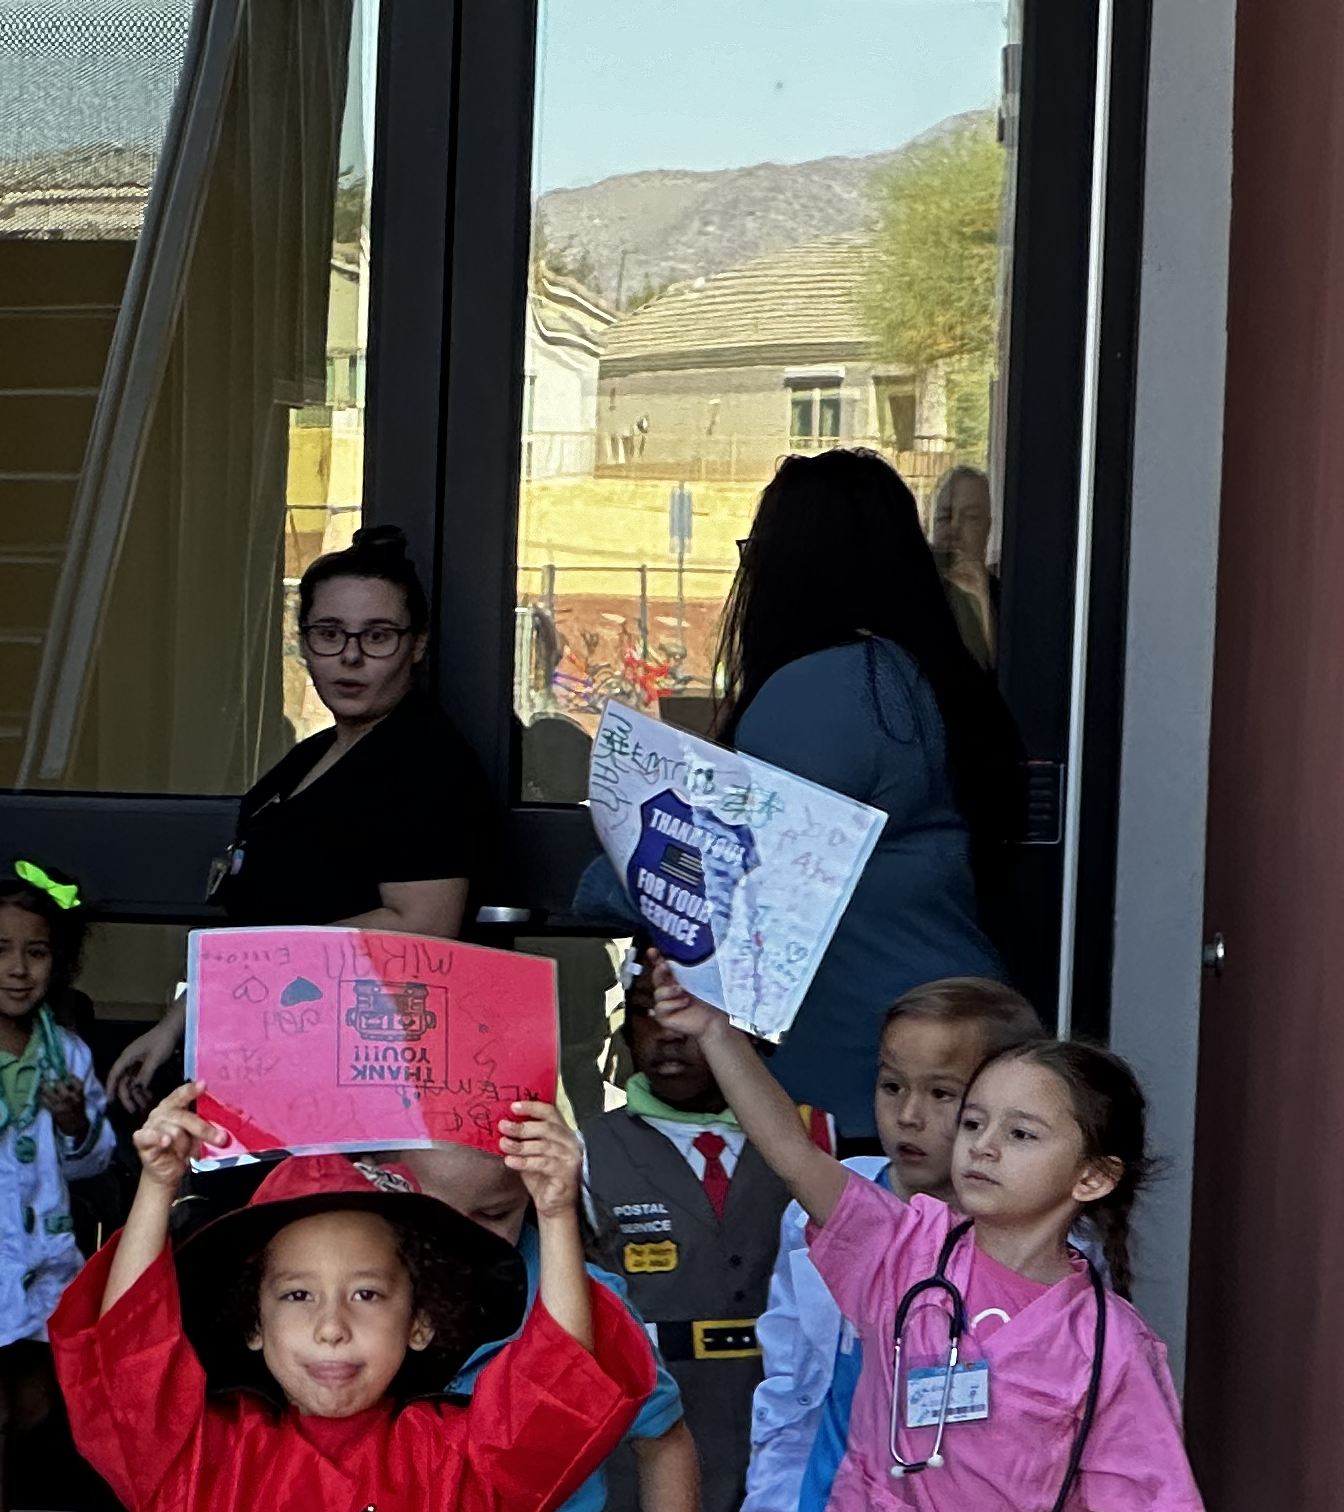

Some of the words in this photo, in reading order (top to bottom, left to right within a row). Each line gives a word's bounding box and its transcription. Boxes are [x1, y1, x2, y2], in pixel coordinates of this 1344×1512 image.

[650, 807, 704, 848] THANK
[637, 867, 667, 901] FOR
[353, 1045, 430, 1064] YOU!!!
[350, 1064, 435, 1084] THANK
[613, 1203, 670, 1217] POSTAL
